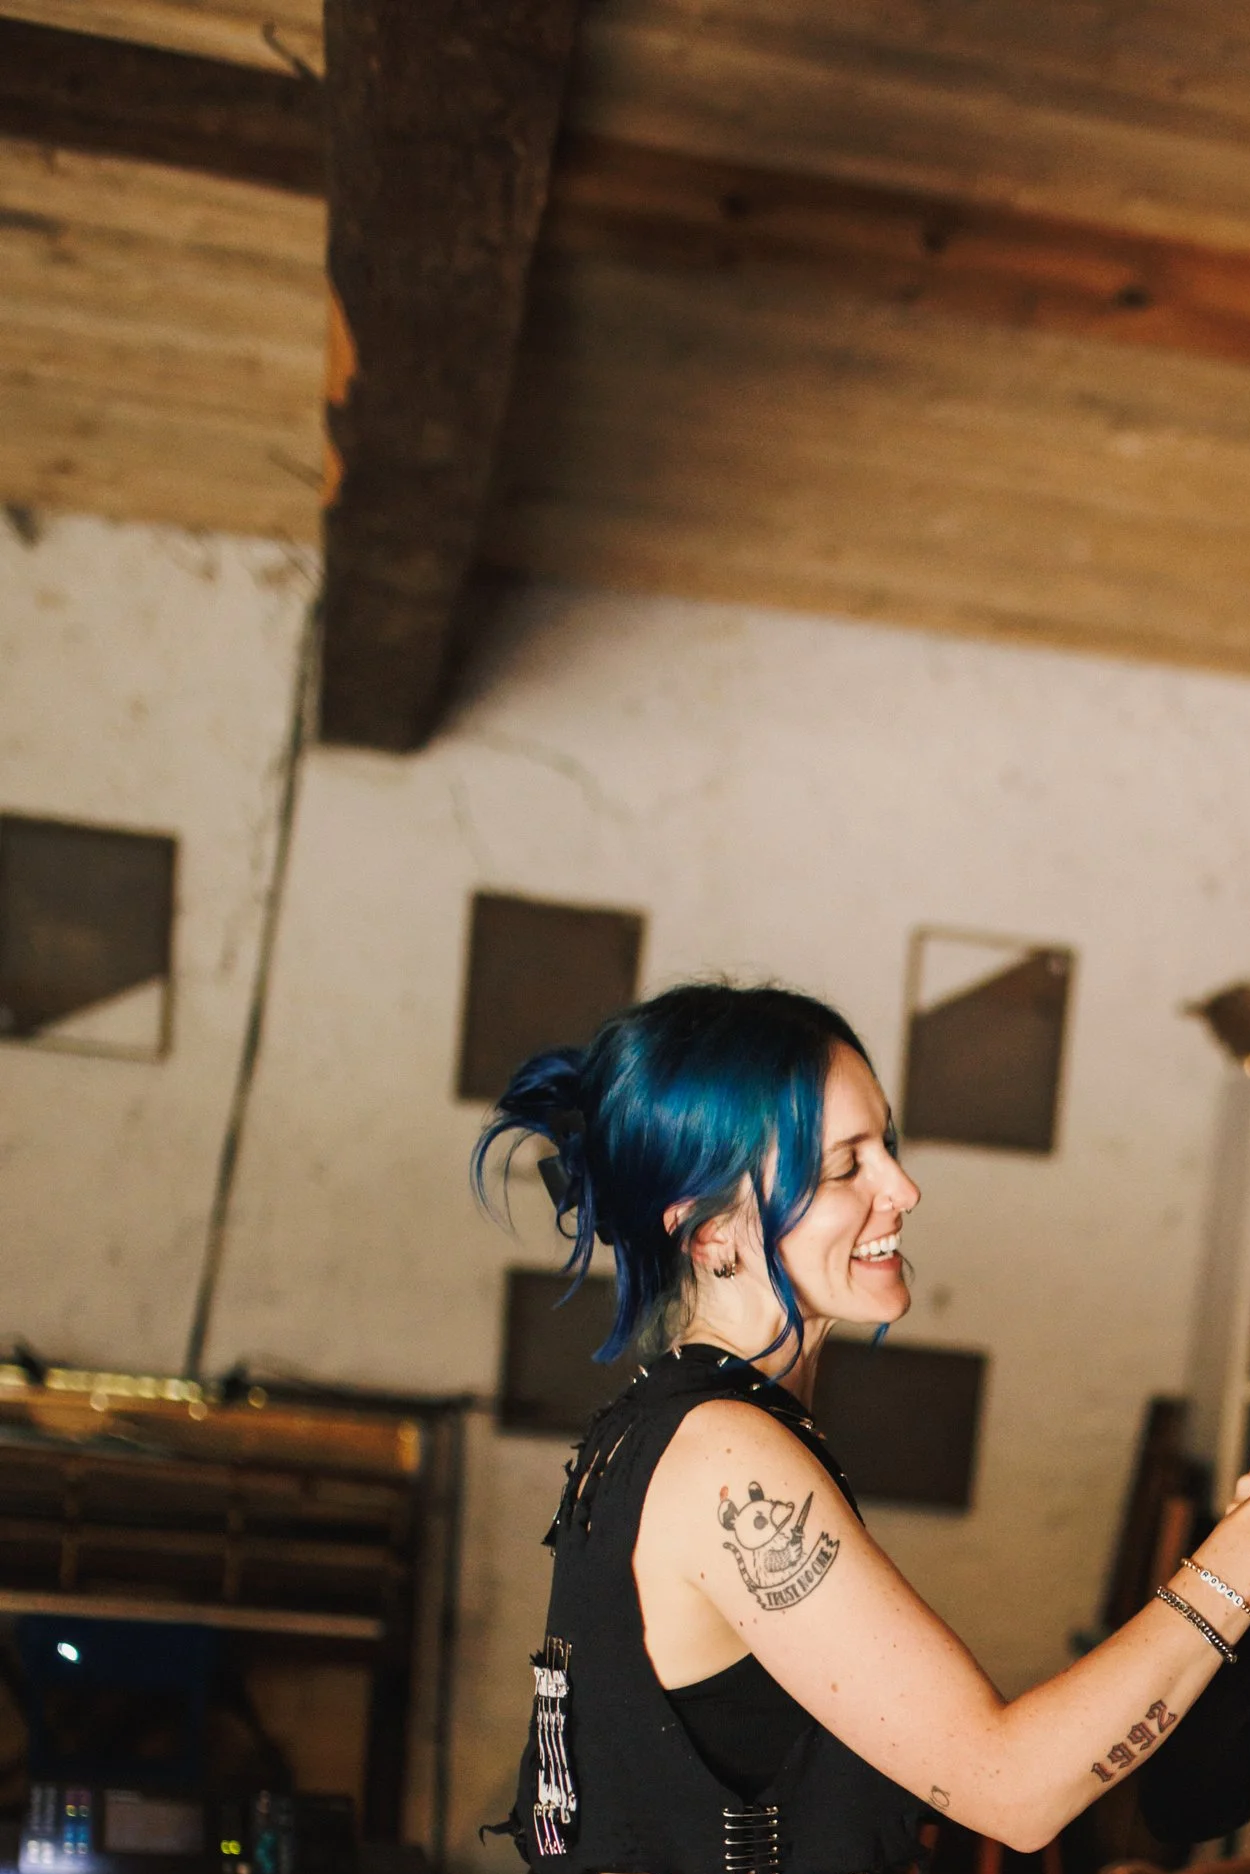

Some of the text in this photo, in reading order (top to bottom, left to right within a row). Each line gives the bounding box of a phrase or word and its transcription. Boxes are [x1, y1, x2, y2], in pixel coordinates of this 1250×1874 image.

[765, 1547, 833, 1606] TRUST NO ONE
[1202, 1571, 1242, 1605] ROYAL
[1090, 1698, 1178, 1783] 1992
